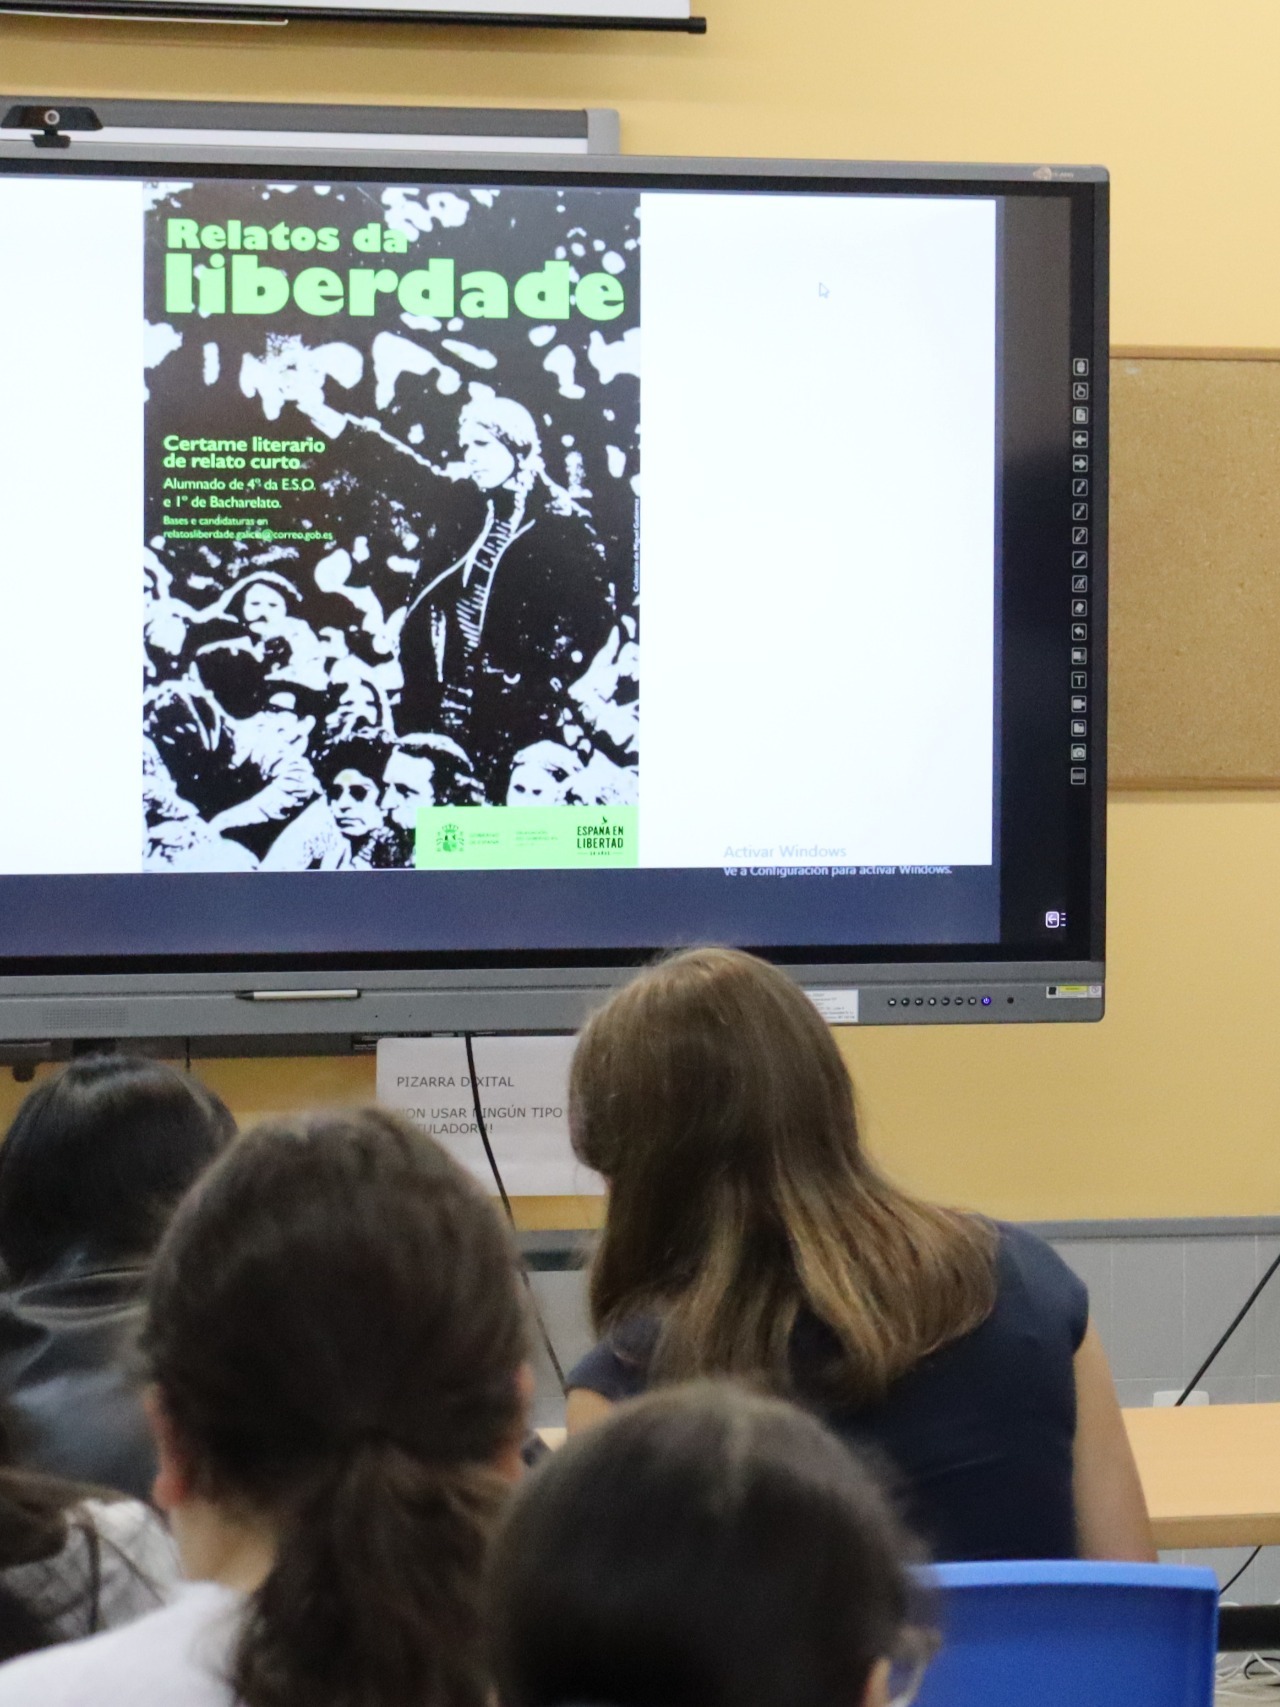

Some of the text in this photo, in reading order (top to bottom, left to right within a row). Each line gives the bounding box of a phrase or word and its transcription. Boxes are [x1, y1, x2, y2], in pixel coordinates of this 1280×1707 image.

[167, 218, 407, 253] Relatos da
[165, 253, 625, 321] liberdade
[163, 435, 326, 453] Certame literario
[163, 453, 301, 470] de relato curto
[163, 477, 226, 490] Alumnado
[229, 478, 244, 490] de
[264, 479, 278, 491] da
[282, 478, 316, 491] E.S.O.
[163, 498, 171, 508] e
[191, 496, 206, 508] de
[210, 496, 282, 509] Bacharelato.
[163, 515, 188, 526] Bases
[191, 518, 197, 526] e
[199, 515, 255, 526] candidaturas
[612, 825, 624, 836] EN
[576, 837, 624, 849] LIBERTAD
[723, 844, 847, 858] Activar Windows
[740, 867, 748, 876] a
[831, 866, 856, 878] para
[397, 1076, 514, 1087] PIZARRA DXITAL
[431, 1107, 467, 1118] USAR
[532, 1107, 563, 1118] TIPO
